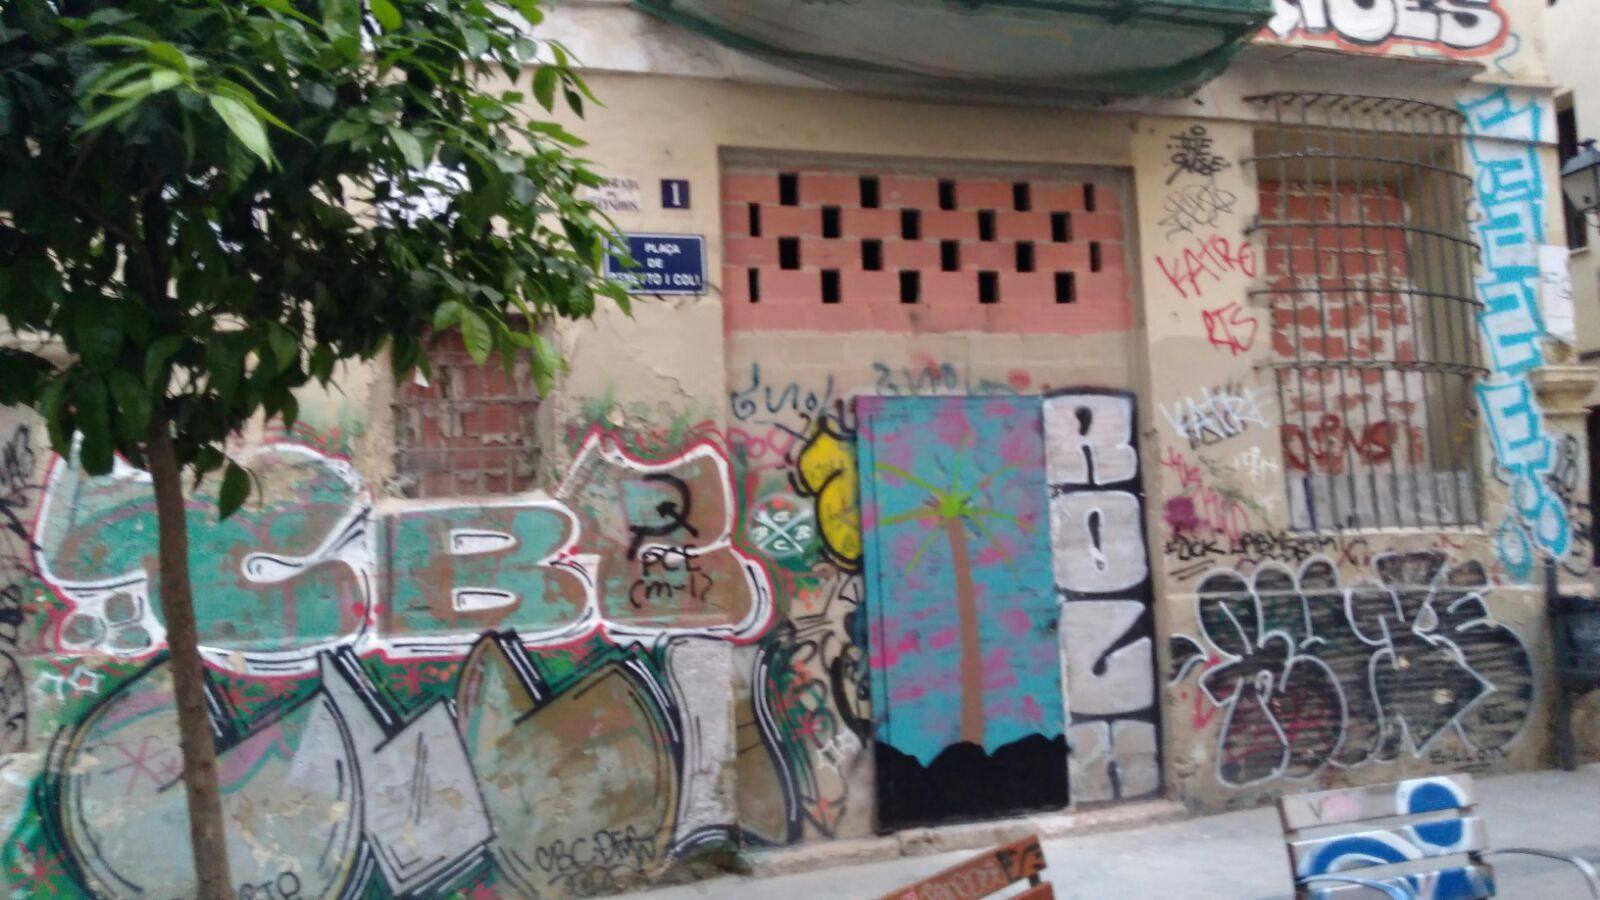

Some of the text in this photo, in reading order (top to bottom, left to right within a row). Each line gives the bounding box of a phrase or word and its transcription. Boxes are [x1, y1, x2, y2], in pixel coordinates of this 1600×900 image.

[671, 182, 681, 206] 1
[644, 243, 681, 256] PLAÇA
[646, 258, 664, 269] DE
[664, 273, 671, 286] I
